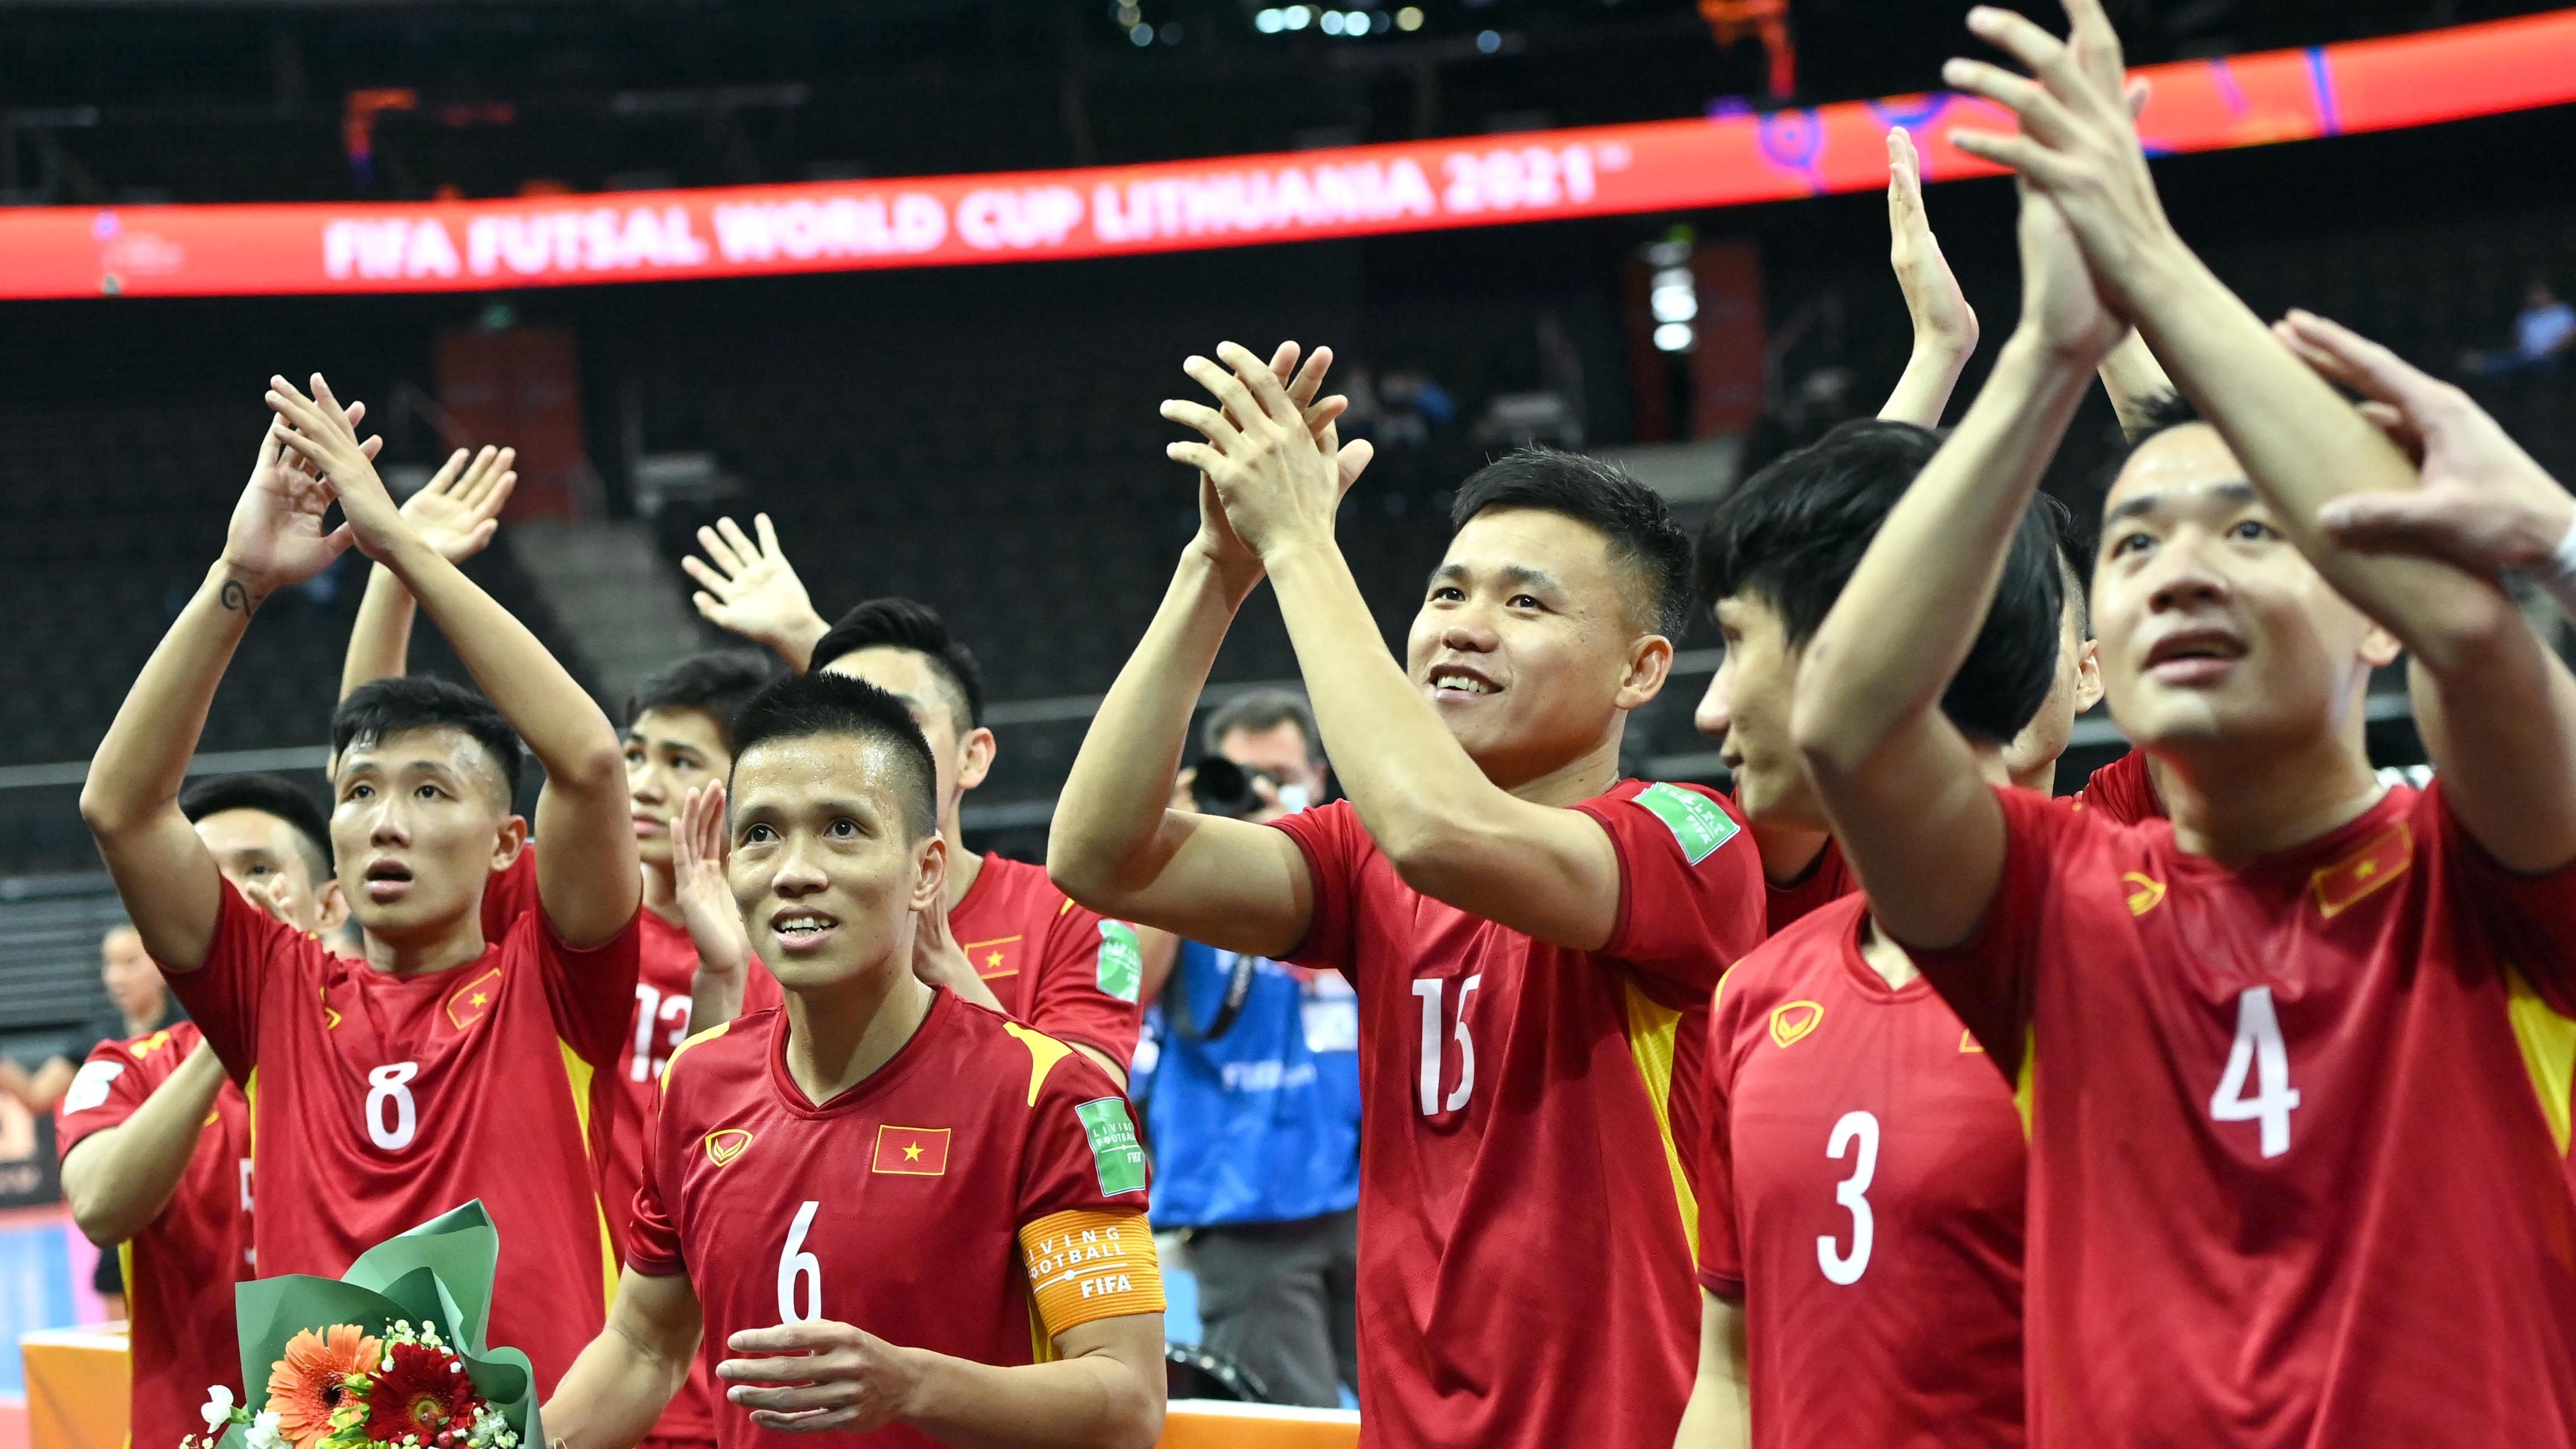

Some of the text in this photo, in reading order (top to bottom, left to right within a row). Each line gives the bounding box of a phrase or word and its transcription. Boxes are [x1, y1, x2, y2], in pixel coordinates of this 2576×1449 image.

[321, 216, 460, 278] FIFA
[466, 203, 708, 275] FUTSAL
[711, 191, 948, 261] WORLD
[955, 185, 1084, 249] CUP
[1092, 157, 1436, 242] LITHUANIA
[365, 1061, 419, 1150] 8
[1412, 974, 1481, 1116] 15
[2210, 985, 2300, 1159] 4
[1027, 1227, 1120, 1264] IVING
[1817, 1110, 1880, 1285] 3
[777, 1201, 822, 1326] 6
[1029, 1243, 1126, 1280] OOTBALL
[1080, 1274, 1133, 1299] FIFA
